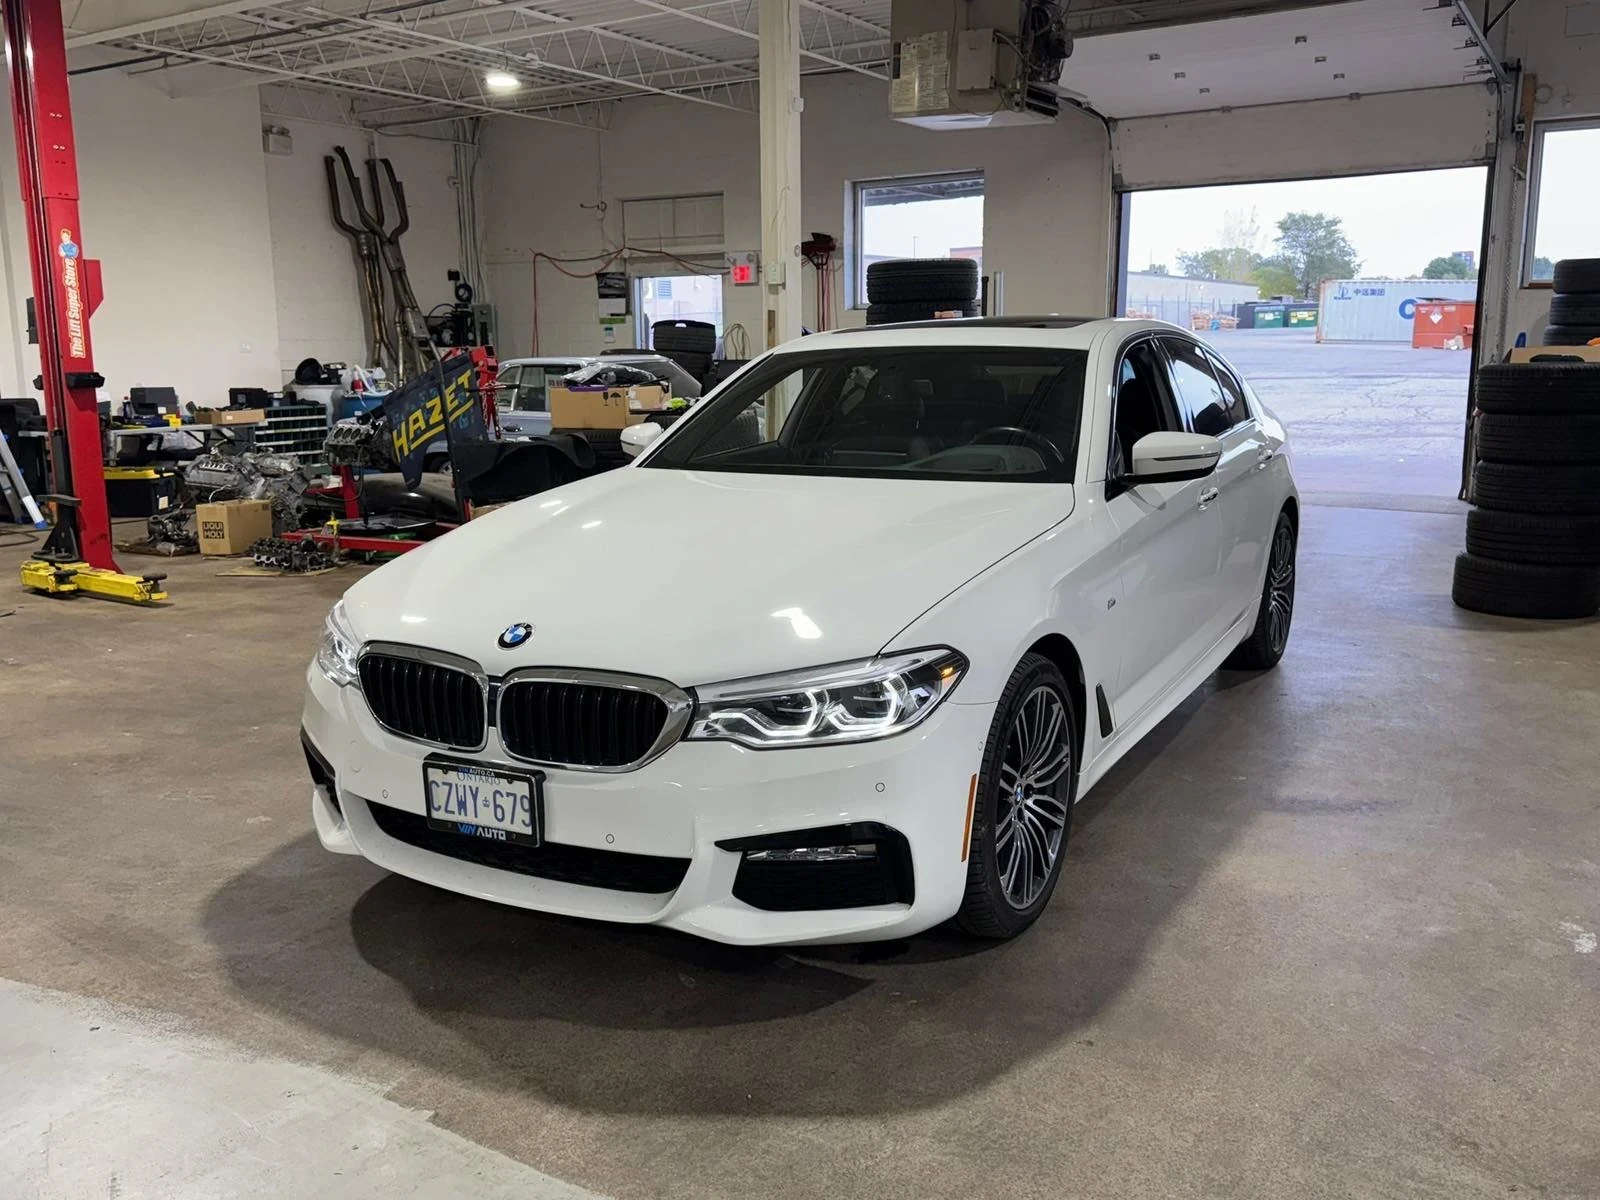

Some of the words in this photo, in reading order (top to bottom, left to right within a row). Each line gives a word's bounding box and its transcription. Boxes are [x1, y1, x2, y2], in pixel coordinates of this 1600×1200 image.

[392, 369, 472, 463] HAZET
[203, 522, 223, 530] LIQUI
[204, 530, 224, 538] MOLY
[429, 780, 479, 819] CZWY
[492, 789, 532, 827] 679
[457, 823, 476, 835] VIN
[476, 827, 506, 840] AUTO
